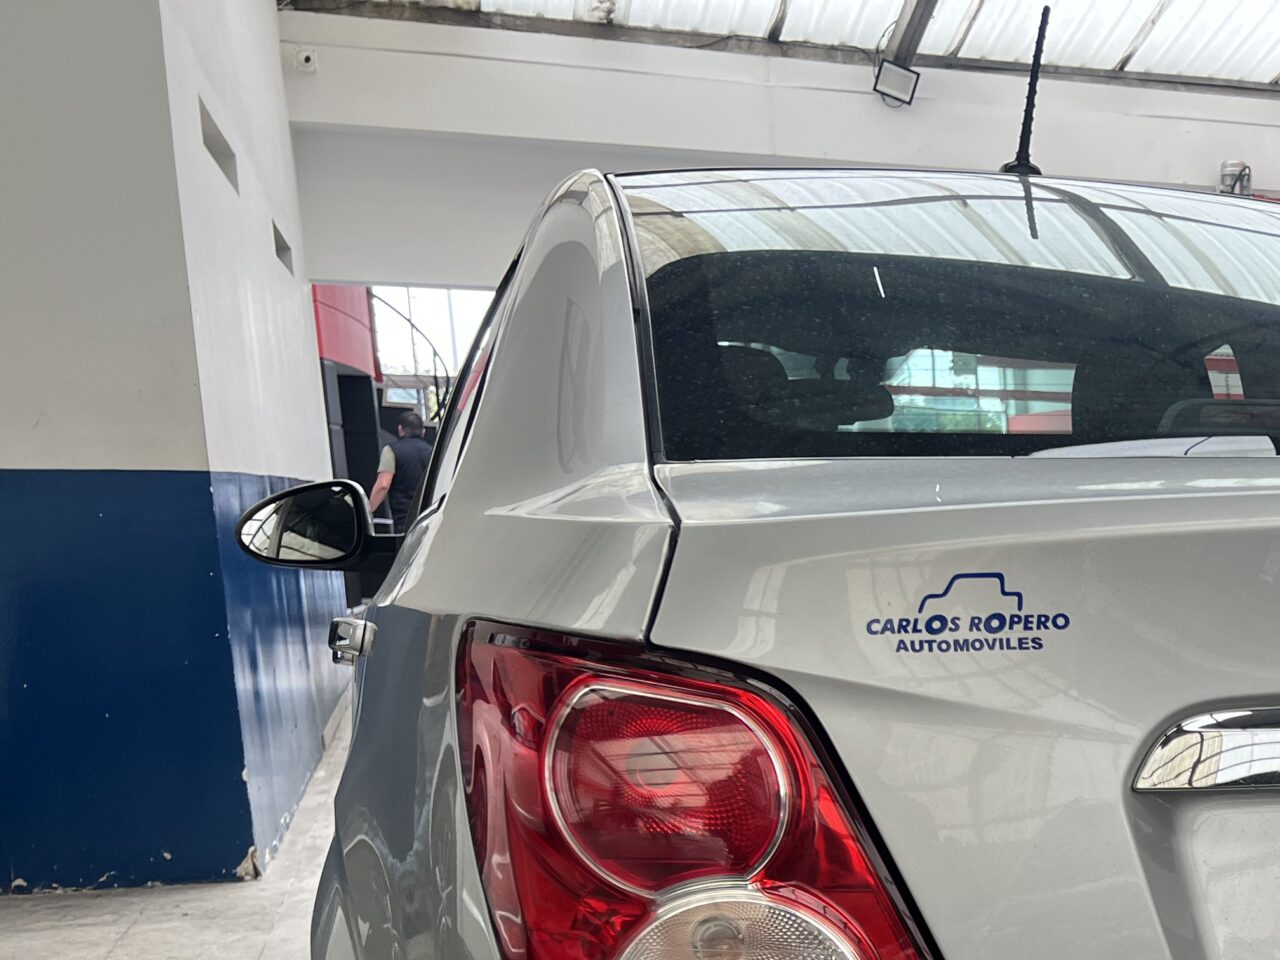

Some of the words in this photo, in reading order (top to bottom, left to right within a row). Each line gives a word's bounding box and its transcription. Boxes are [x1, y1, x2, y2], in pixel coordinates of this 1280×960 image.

[866, 614, 961, 635] CARLOS
[968, 612, 1071, 634] ROPERO
[895, 637, 1044, 653] AUTOMOVILES
